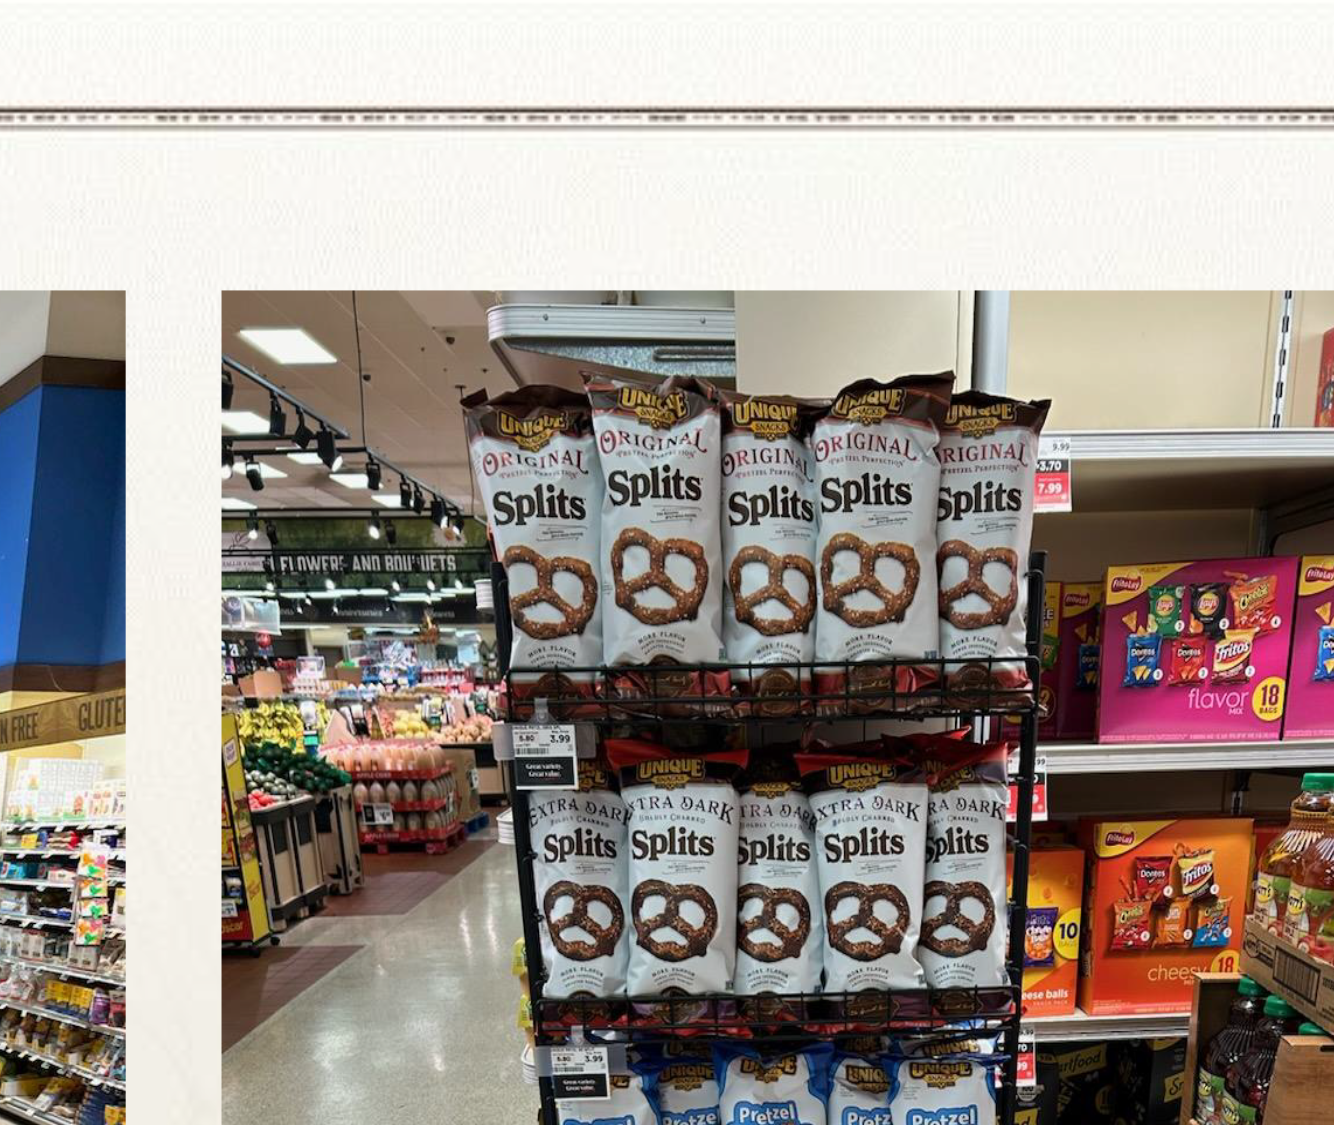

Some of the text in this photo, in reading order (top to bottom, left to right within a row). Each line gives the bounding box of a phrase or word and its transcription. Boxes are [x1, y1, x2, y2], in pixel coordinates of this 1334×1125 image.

[850, 407, 885, 418] SNACKS
[755, 422, 789, 431] SNACKS
[600, 428, 707, 454] ORIGINAL
[815, 432, 917, 462] ORIGINAL
[483, 450, 589, 476] ORIGINAL
[722, 448, 814, 483] ORIGINAL
[608, 464, 702, 507] Splits
[821, 472, 912, 514] Splits
[1038, 483, 1062, 494] 7.99
[493, 484, 586, 526] Splits
[728, 485, 814, 526] Splits
[938, 481, 1022, 522] Splits
[353, 557, 381, 571] AND
[867, 634, 893, 646] FLAVOR
[1216, 641, 1249, 661] Fritos
[1131, 648, 1155, 657] Doritos
[1177, 648, 1201, 657] Doritos
[1188, 688, 1249, 709] flavor
[1261, 684, 1279, 706] 18
[78, 696, 125, 731] GLUTE
[12, 712, 39, 741] FREE
[550, 734, 570, 743] 3.99
[638, 759, 704, 780] UNIQUE
[830, 763, 896, 784] UNIQUE
[530, 797, 579, 828] EXTRA
[681, 796, 734, 825] DARK
[872, 795, 920, 822] DARK
[956, 797, 1004, 821] DARK
[544, 827, 618, 863] Splits
[632, 826, 714, 861] Splits
[824, 827, 905, 863] Splits
[1140, 869, 1165, 879] Doritos
[1183, 863, 1212, 885] Fritos
[1059, 922, 1078, 939] 10
[1148, 964, 1208, 983] cheesy
[1218, 957, 1234, 972] 18
[1046, 989, 1068, 999] balls
[585, 1055, 603, 1063] 3.99
[910, 1063, 972, 1078] UNIQUE
[739, 1103, 796, 1125] Pretzel
